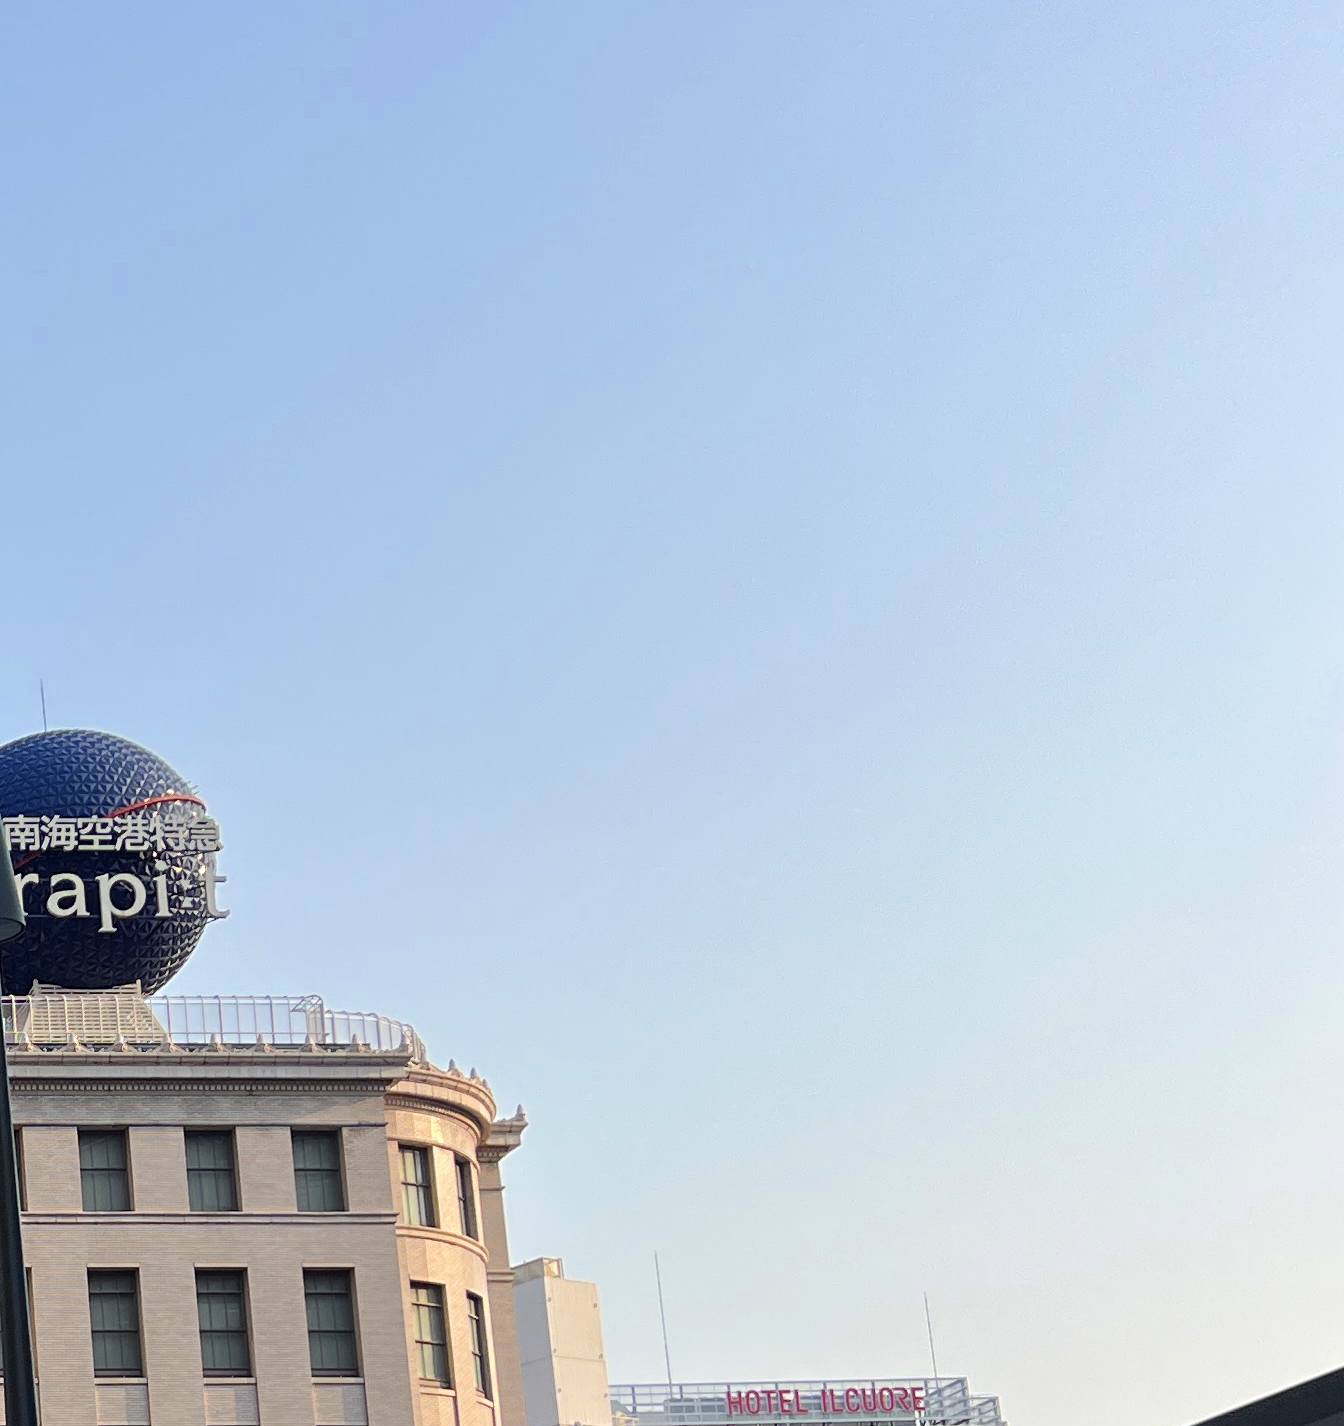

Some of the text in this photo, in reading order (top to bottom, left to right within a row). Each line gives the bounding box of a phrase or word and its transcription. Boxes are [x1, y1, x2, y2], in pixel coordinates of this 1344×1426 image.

[3, 814, 223, 852] 南海空港特急
[726, 1386, 927, 1415] HOTEL ILCUORE
